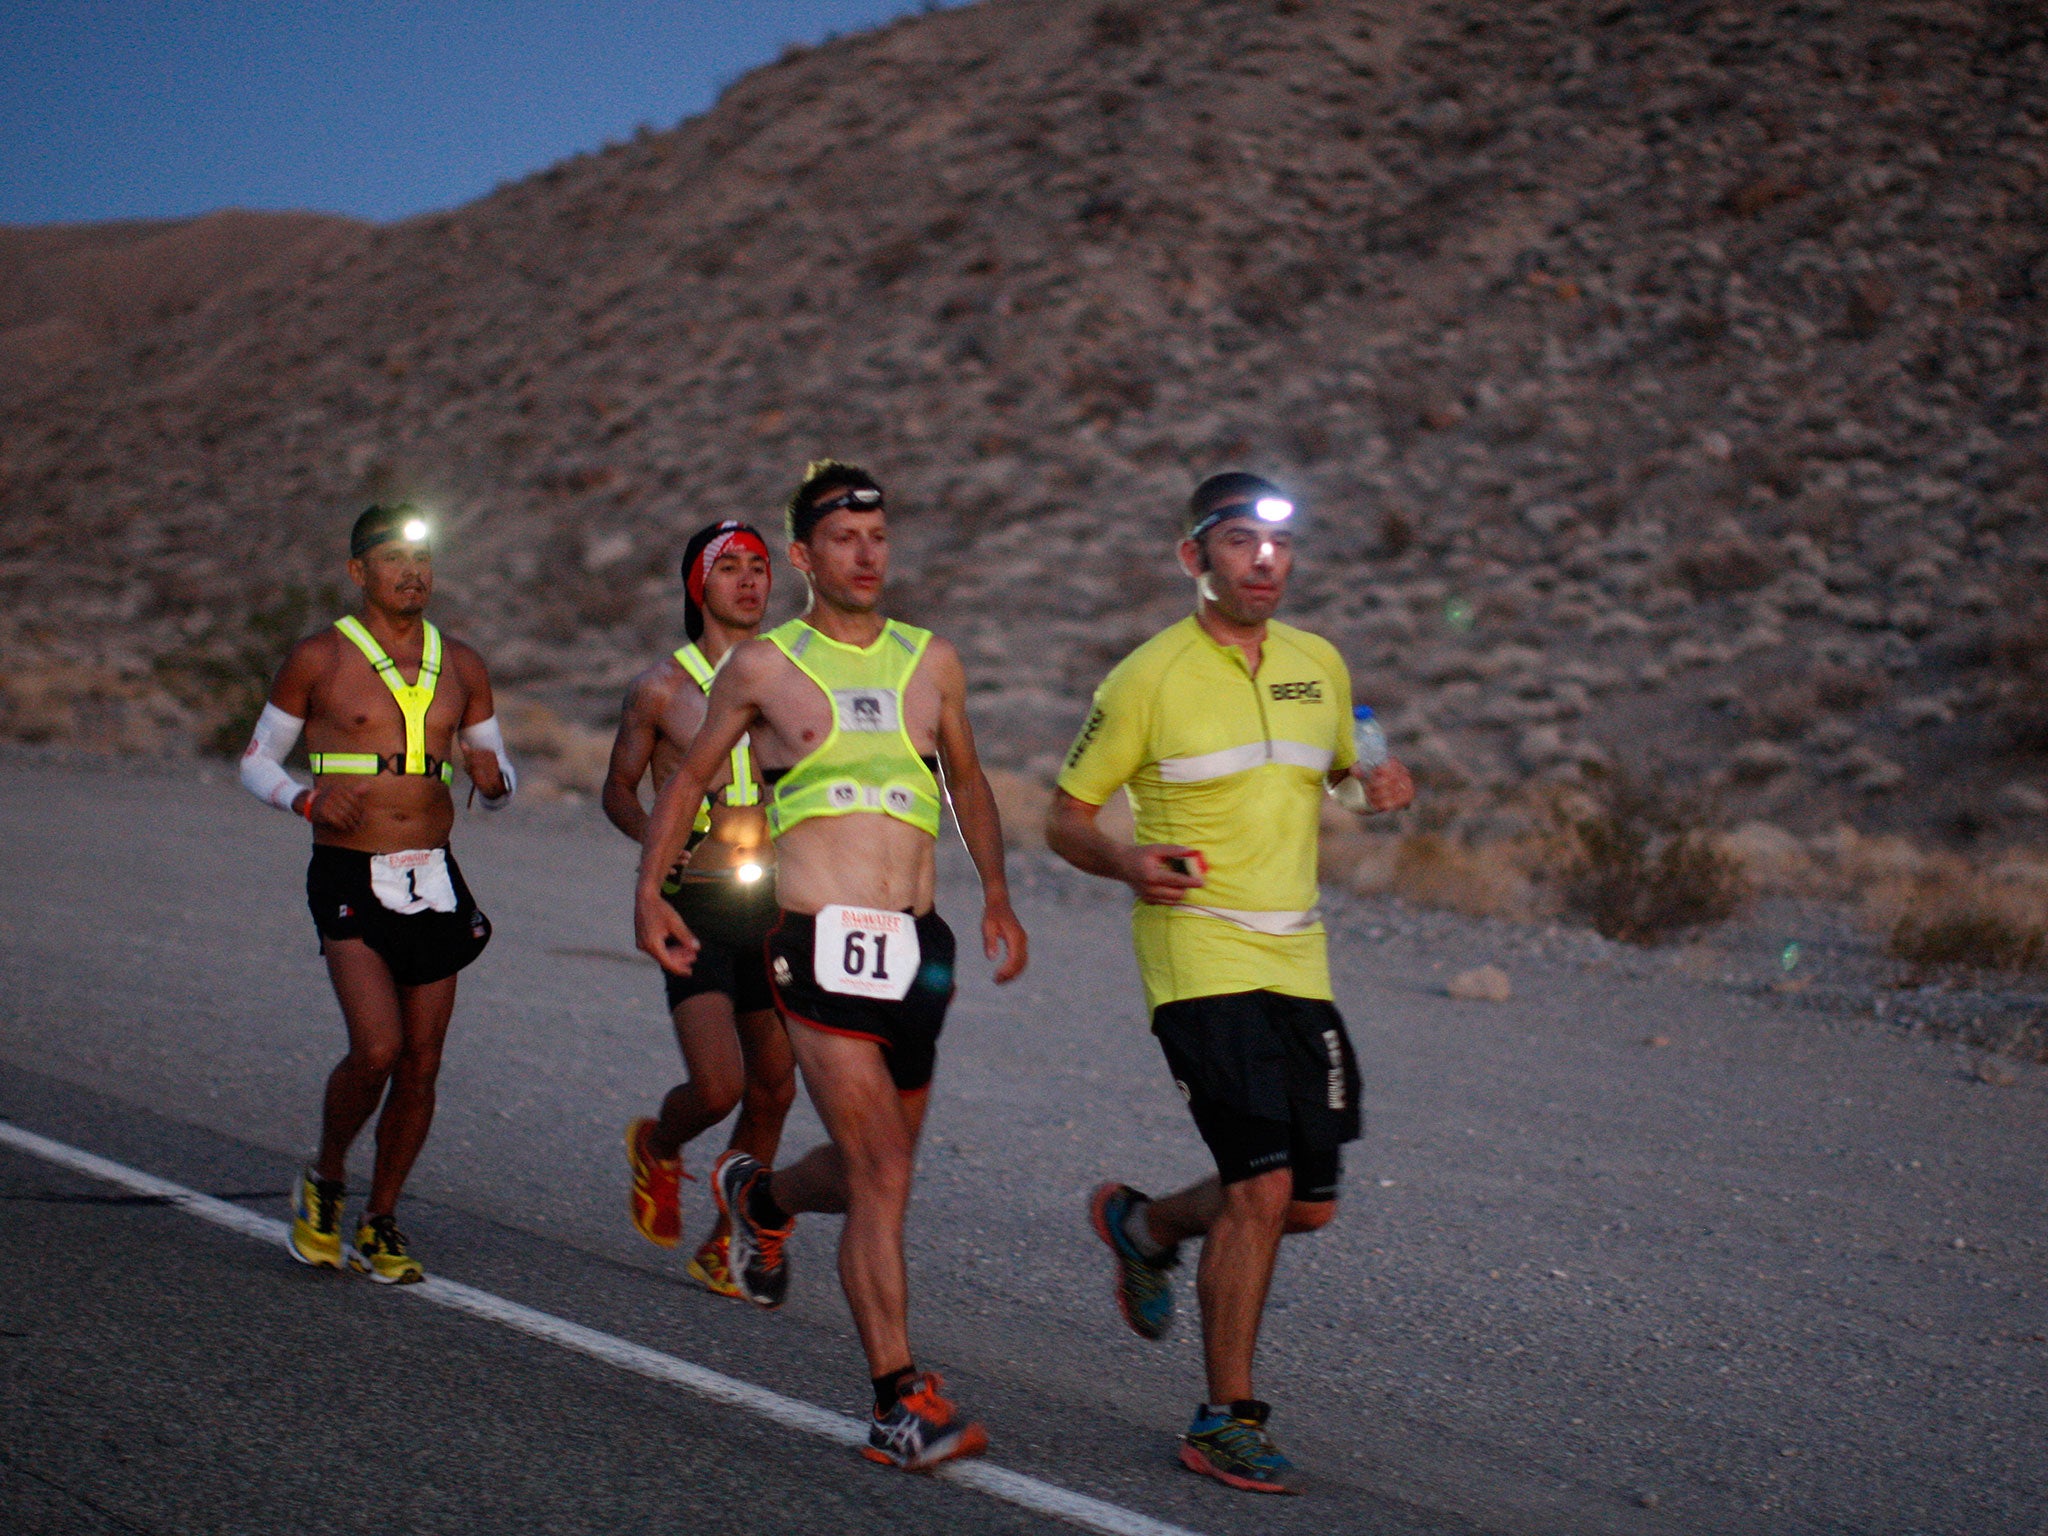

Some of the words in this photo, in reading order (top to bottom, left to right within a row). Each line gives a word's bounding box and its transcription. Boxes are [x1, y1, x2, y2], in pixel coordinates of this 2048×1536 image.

[1270, 680, 1322, 701] BERG
[406, 868, 423, 902] 1
[843, 930, 889, 980] 61
